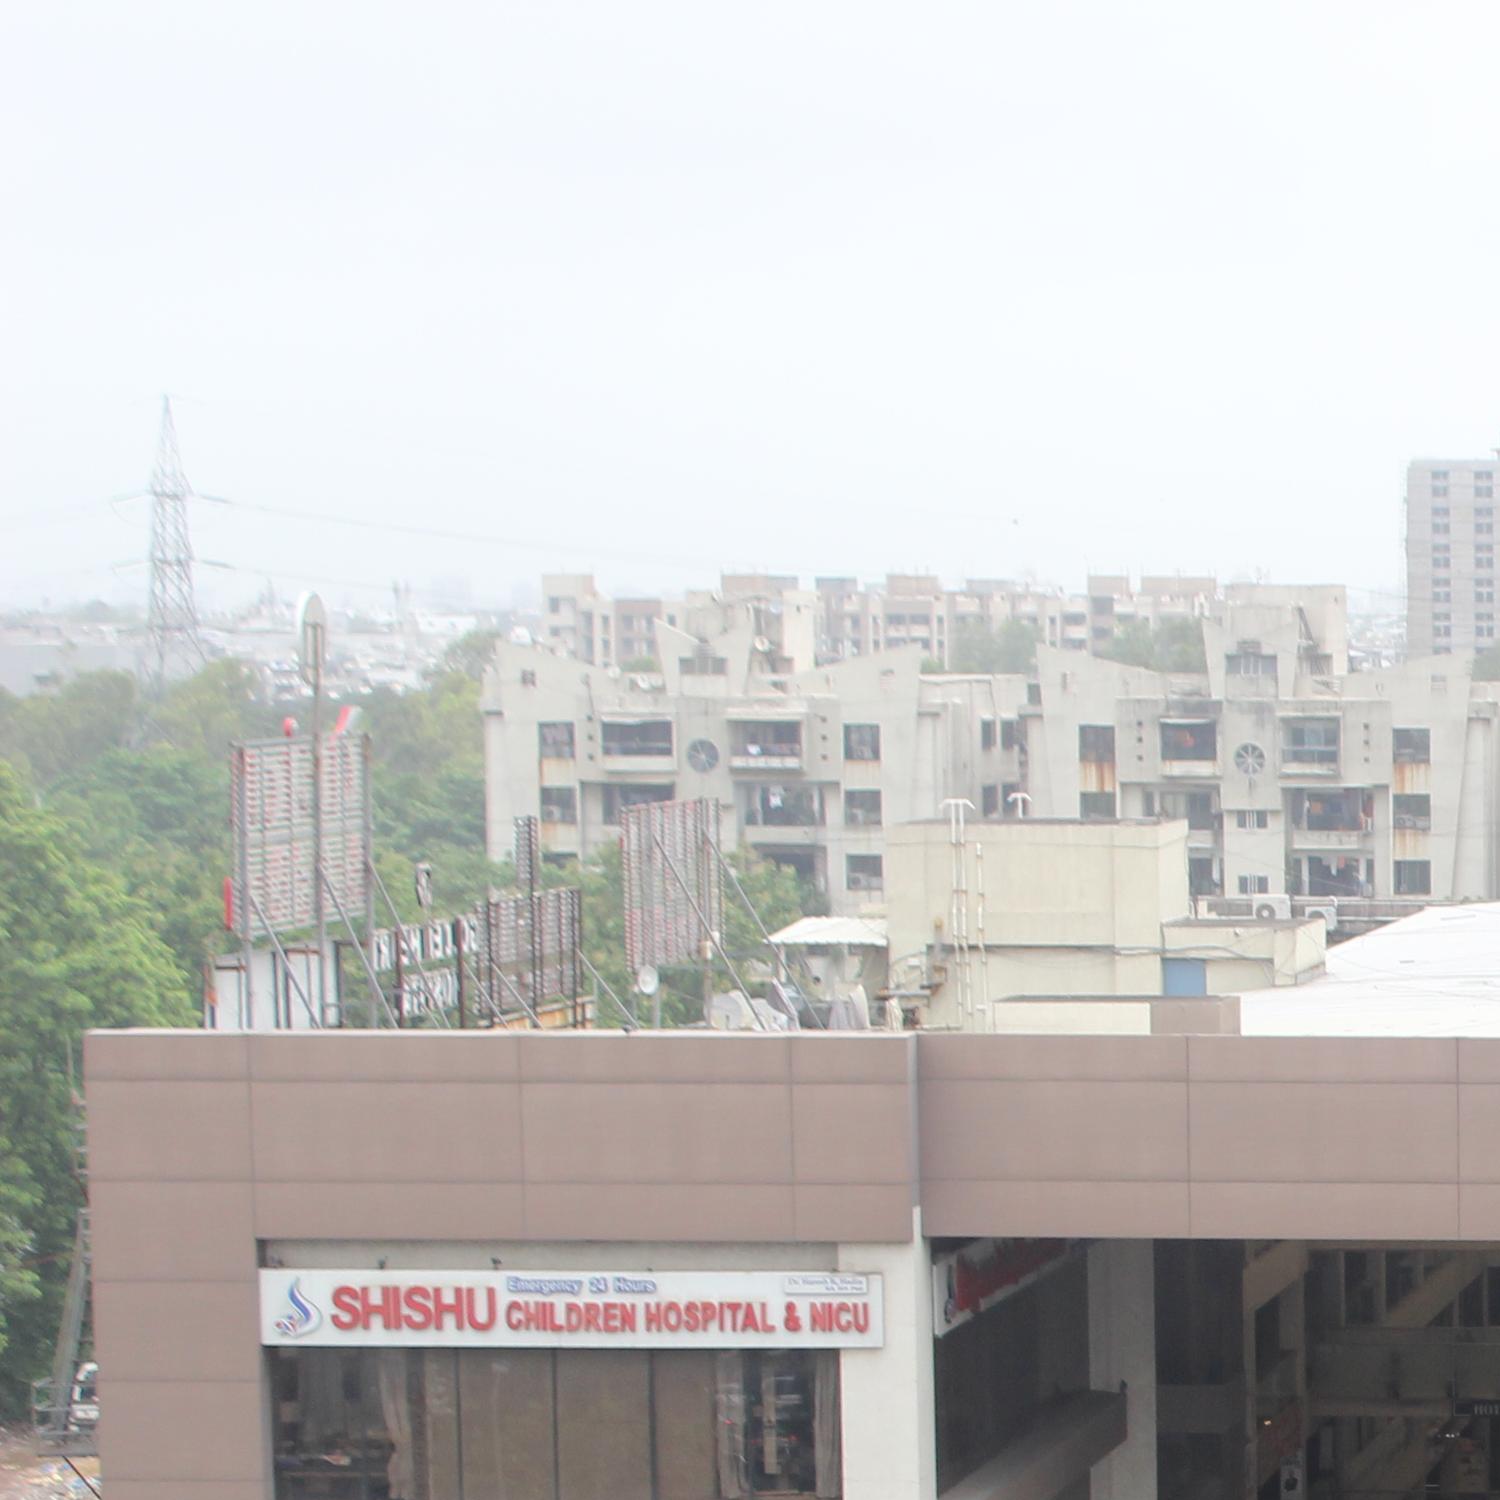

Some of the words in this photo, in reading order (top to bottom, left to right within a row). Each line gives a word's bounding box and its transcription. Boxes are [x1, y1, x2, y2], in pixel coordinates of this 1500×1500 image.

[506, 1276, 582, 1297] Emergency
[613, 1277, 657, 1294] Hours
[331, 1285, 497, 1331] SHISHU
[505, 1301, 637, 1333] CHILDREN
[644, 1301, 776, 1333] HOSPITAL
[784, 1302, 802, 1332] &
[810, 1302, 869, 1333] NICU
